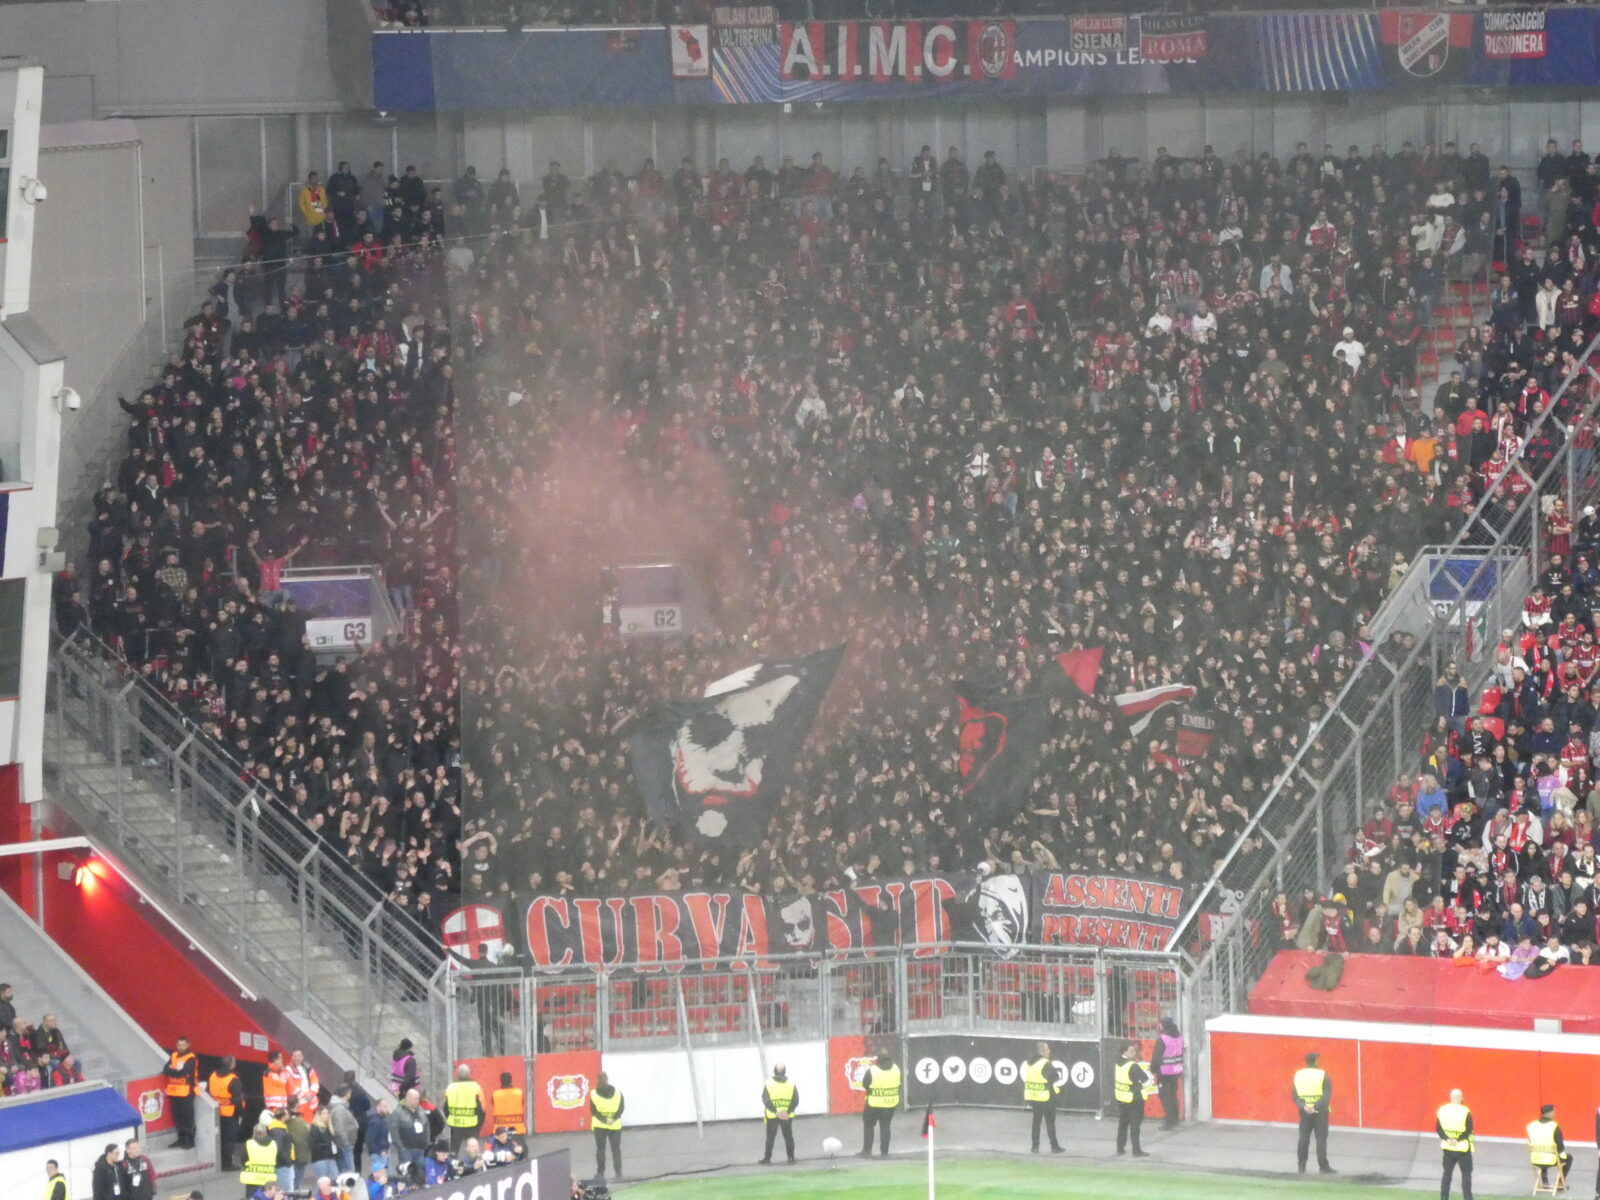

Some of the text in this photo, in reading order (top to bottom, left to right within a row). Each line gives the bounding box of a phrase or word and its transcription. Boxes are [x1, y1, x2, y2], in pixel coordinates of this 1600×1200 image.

[748, 6, 773, 24] CLUB
[1073, 17, 1123, 31] MILAN CLUB
[1483, 11, 1545, 31] COMMESSAGGIO
[719, 27, 773, 47] VALTIBERINA
[1073, 32, 1122, 49] SIENA
[1146, 36, 1205, 55] ROMA
[783, 25, 971, 77] A.I.M.C.
[1013, 49, 1107, 66] AMPIONS
[654, 609, 676, 628] G2
[344, 622, 366, 641] G3
[1042, 874, 1183, 919] ASSENTI
[527, 893, 780, 974] CURVA
[1042, 914, 1174, 952] PRESENTI
